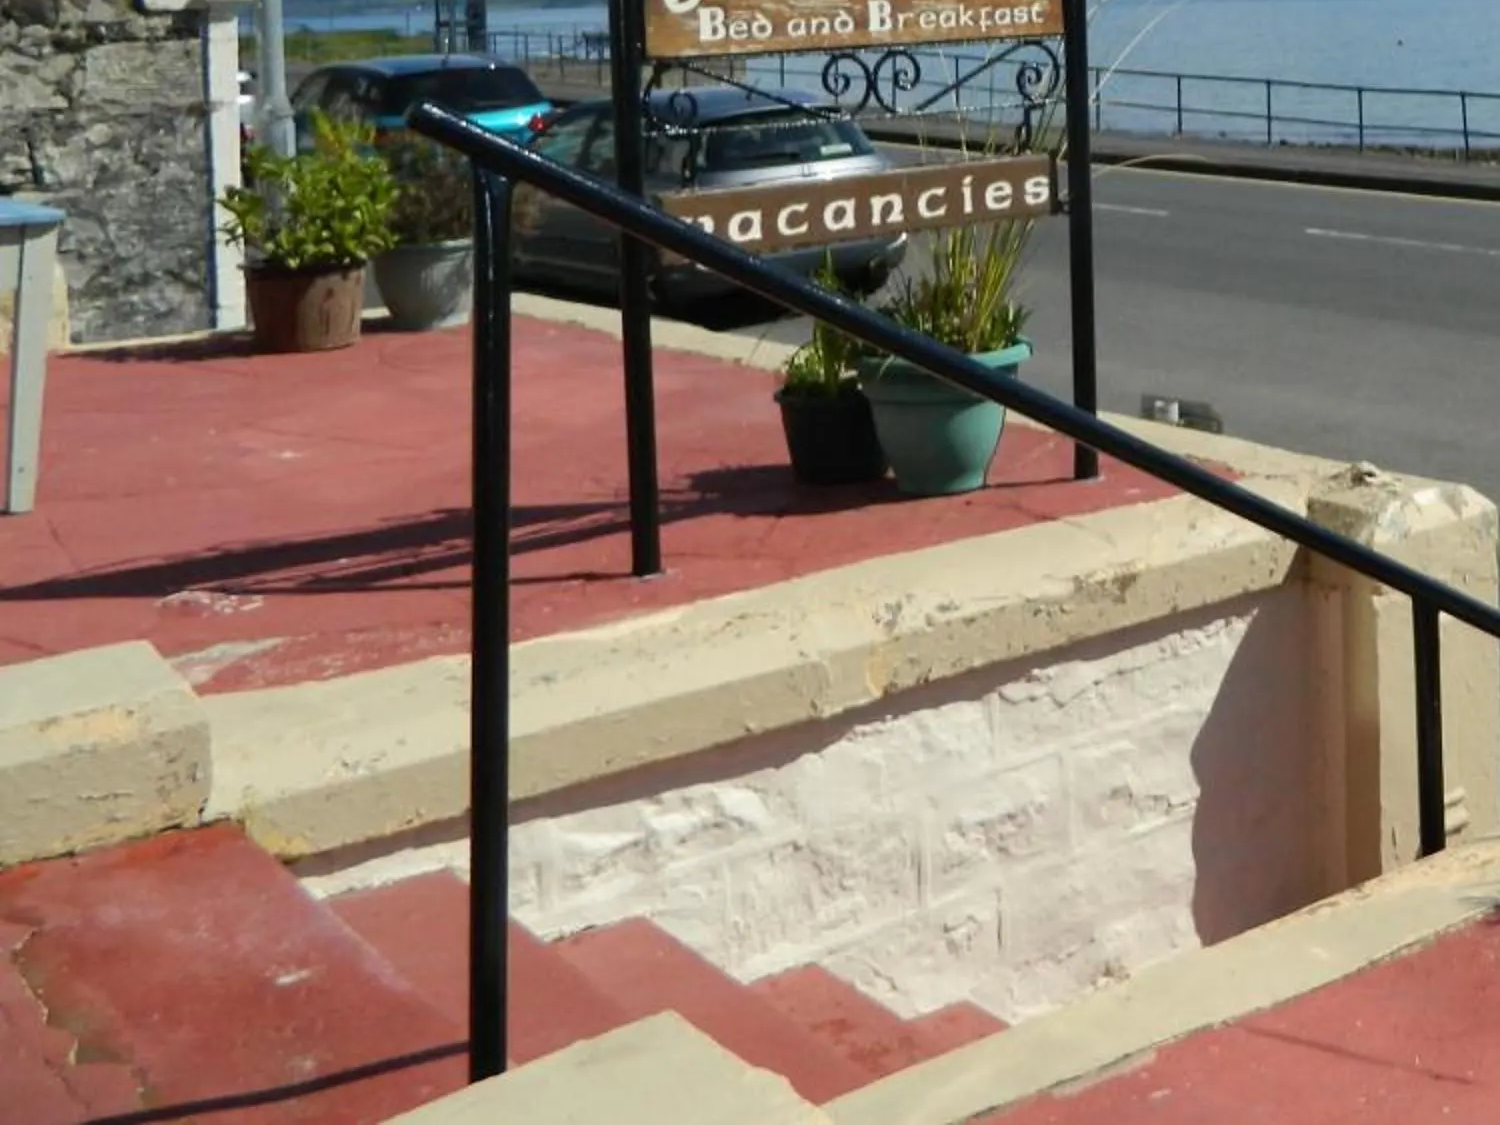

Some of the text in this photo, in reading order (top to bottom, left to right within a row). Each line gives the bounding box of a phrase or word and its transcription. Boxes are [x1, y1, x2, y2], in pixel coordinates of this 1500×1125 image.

[699, 0, 1045, 41] Bed and Breakfast
